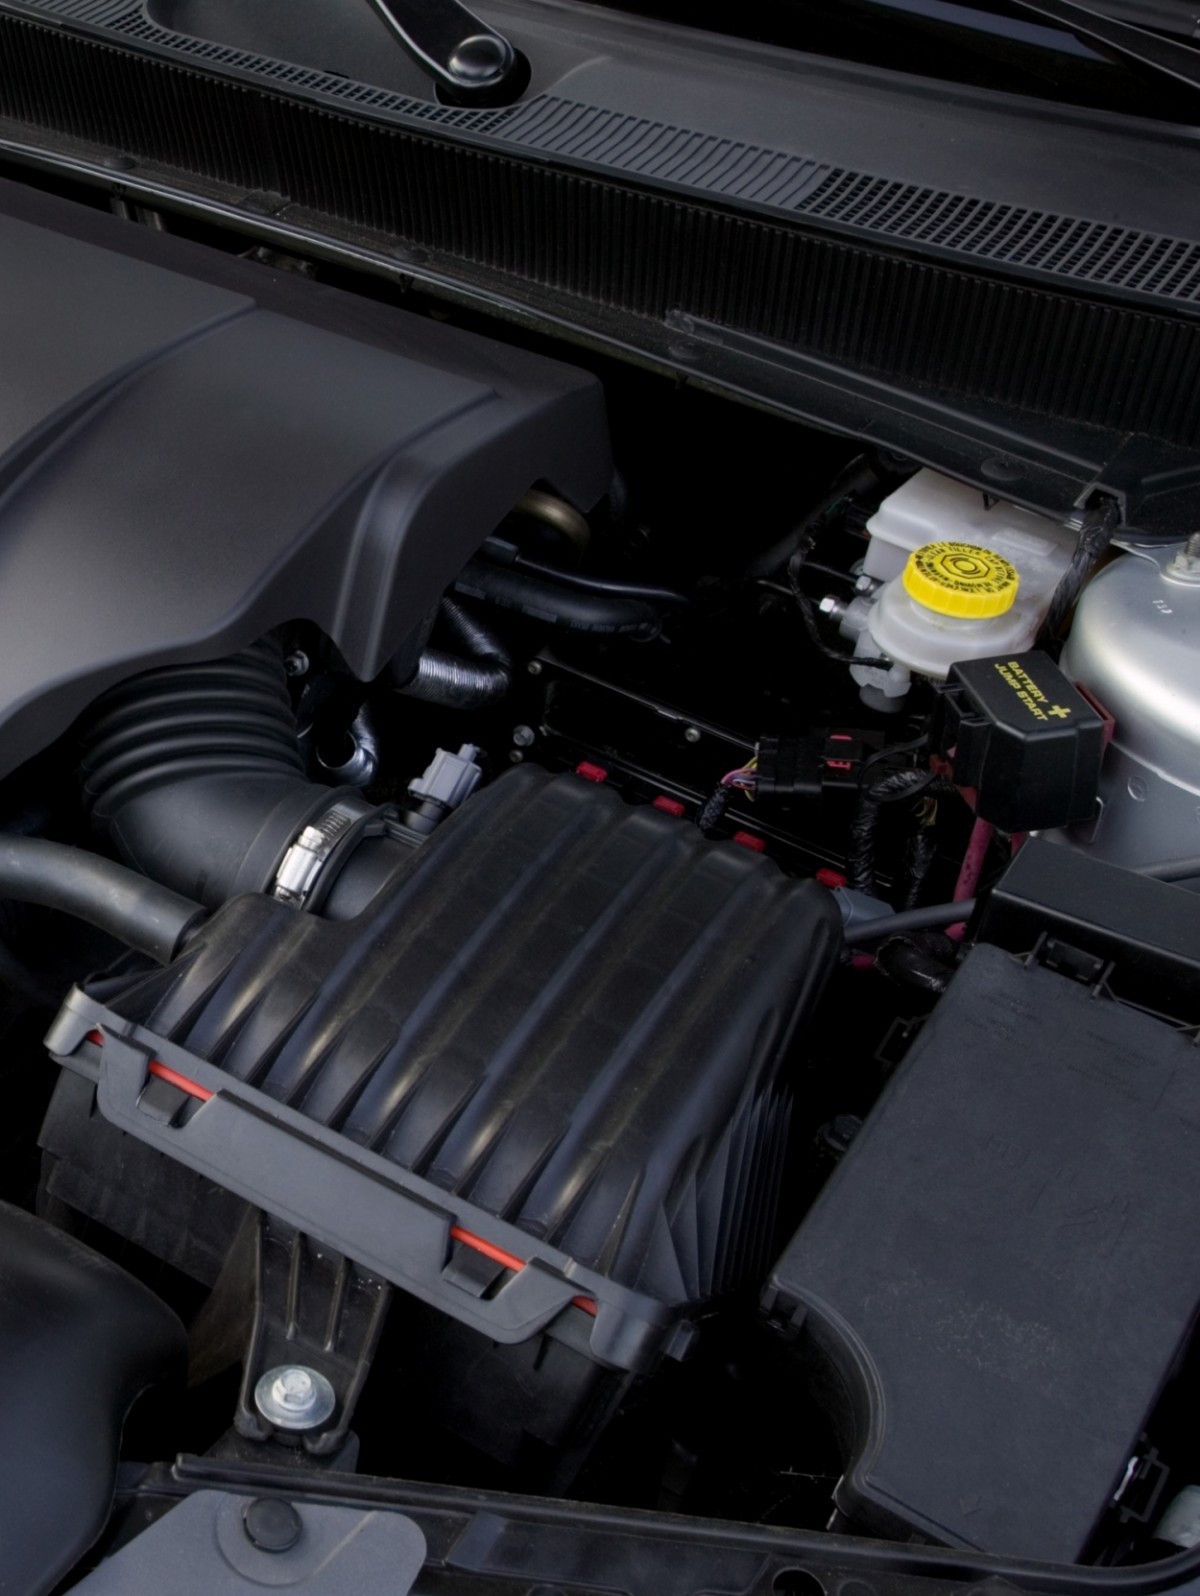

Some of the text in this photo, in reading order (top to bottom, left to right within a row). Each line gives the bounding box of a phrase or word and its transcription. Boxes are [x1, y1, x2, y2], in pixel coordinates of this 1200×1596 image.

[994, 663, 1048, 721] JUMP START
[1007, 661, 1048, 703] BATTERY
